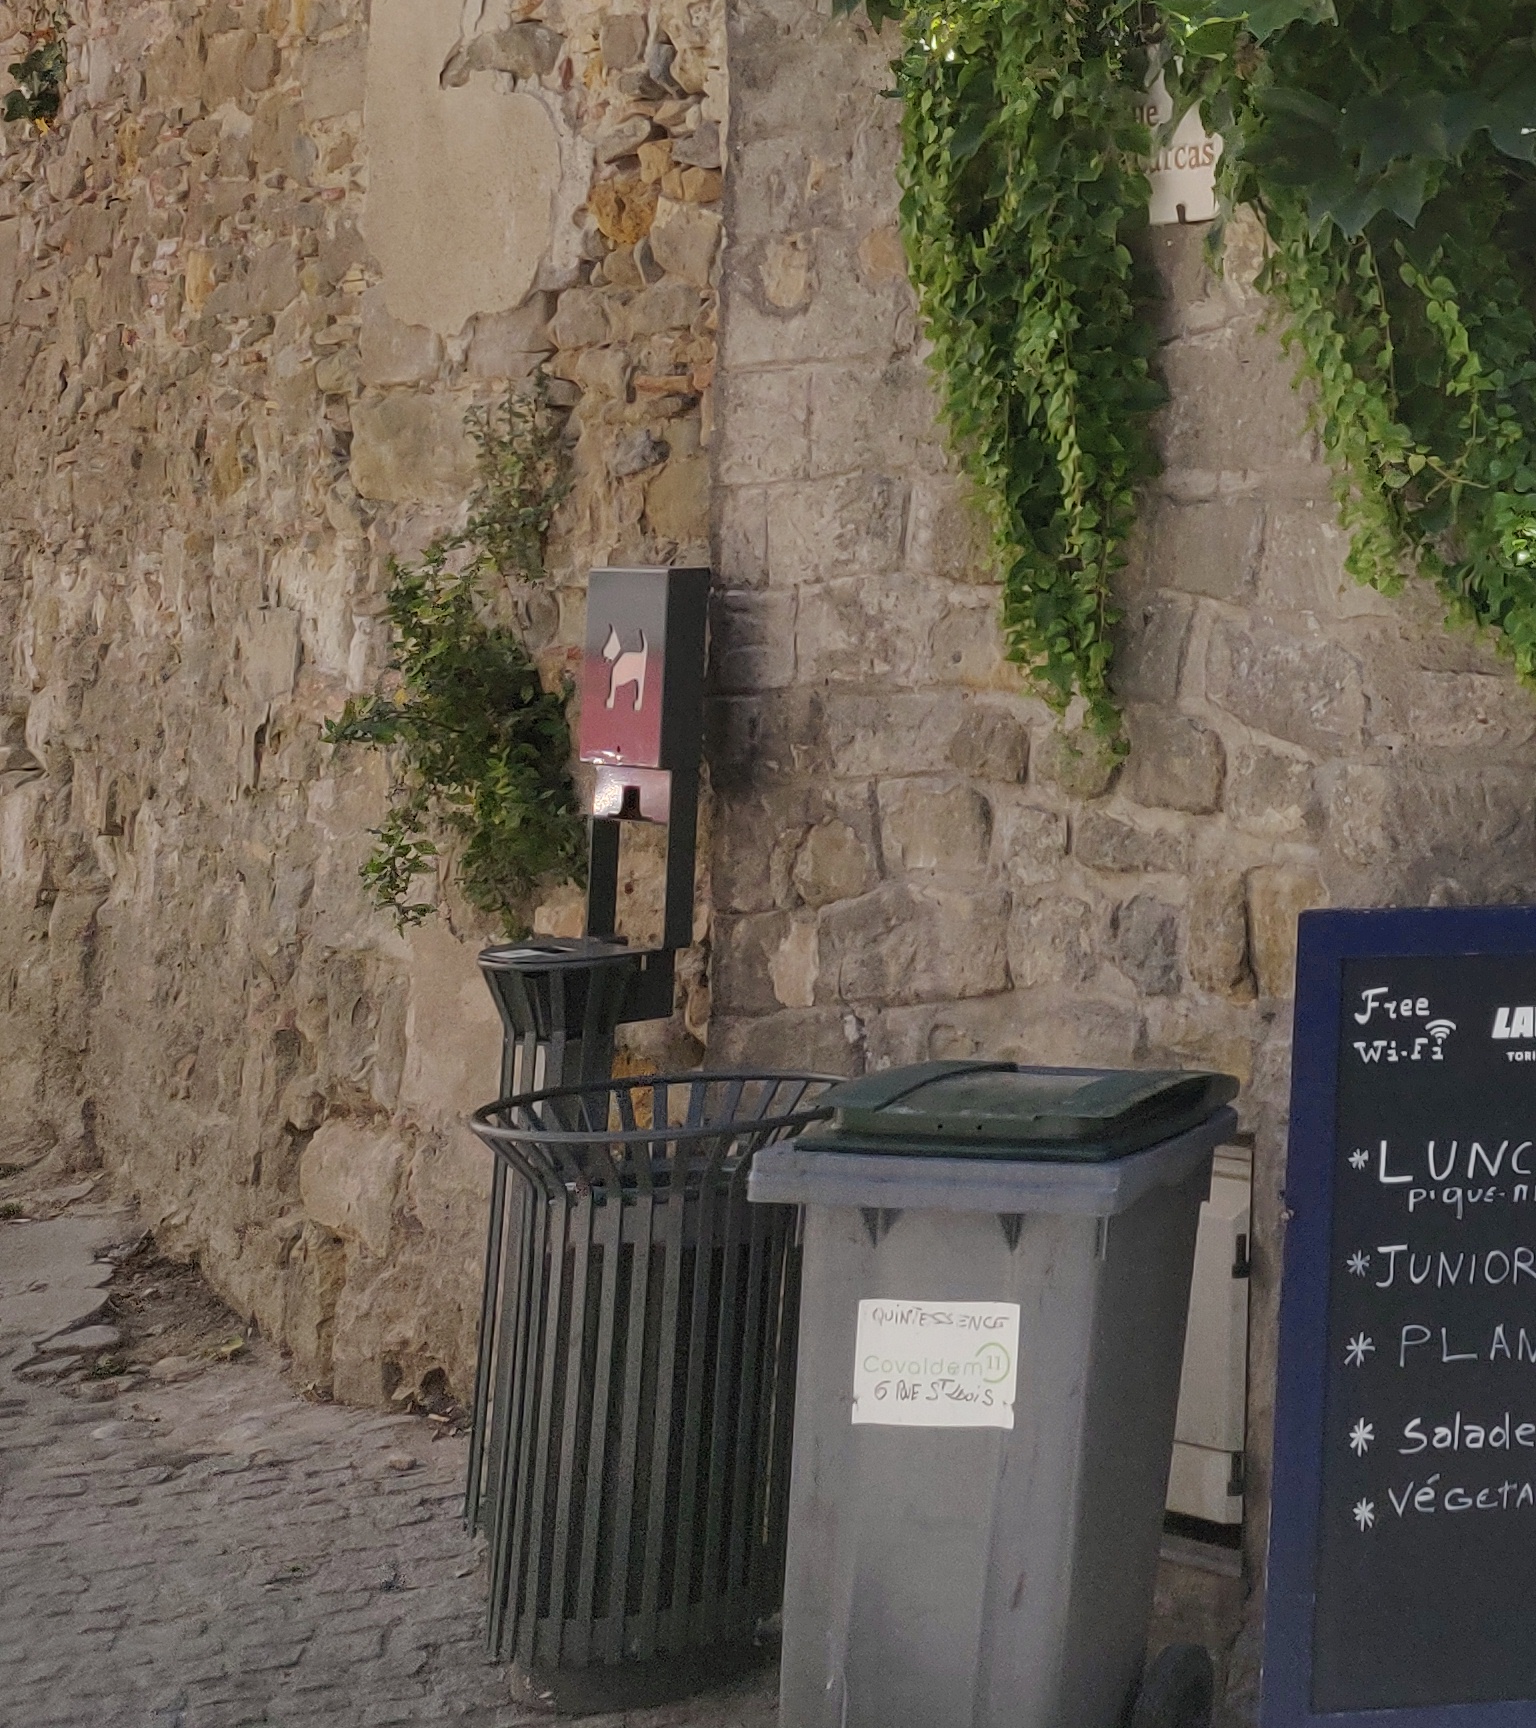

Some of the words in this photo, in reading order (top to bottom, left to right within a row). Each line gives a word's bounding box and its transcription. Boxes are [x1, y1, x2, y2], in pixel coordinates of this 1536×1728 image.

[1354, 987, 1430, 1025] Free
[1354, 1038, 1444, 1063] Wi-Fi
[874, 1380, 891, 1401] 6
[1399, 1411, 1535, 1454] Salade
